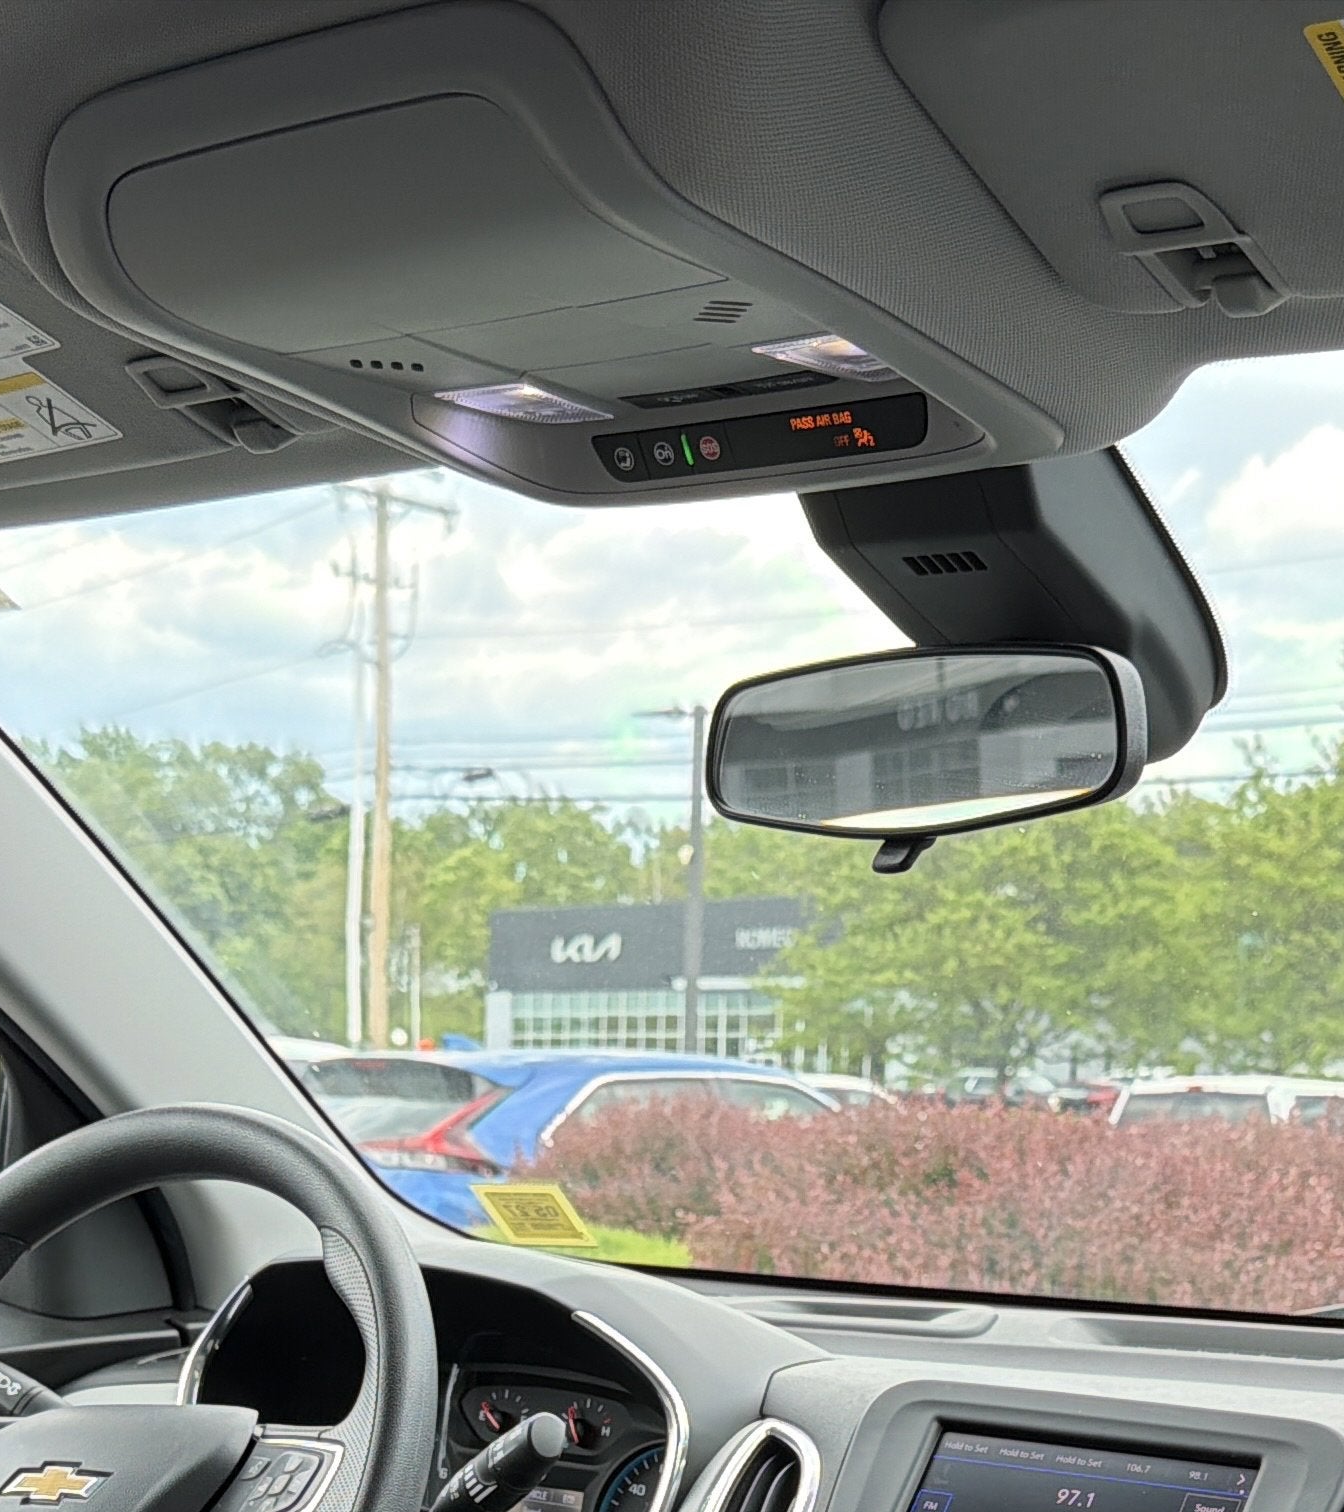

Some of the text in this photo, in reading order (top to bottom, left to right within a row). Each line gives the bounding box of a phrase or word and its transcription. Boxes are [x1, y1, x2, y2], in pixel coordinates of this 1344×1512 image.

[789, 410, 852, 431] PASS AIR BAG
[834, 434, 850, 447] OFF
[944, 1441, 963, 1451] Hold
[973, 1443, 989, 1454] Set
[999, 1448, 1019, 1458] Hold
[1028, 1450, 1045, 1461] Set
[1056, 1454, 1076, 1465] Hold
[1086, 1457, 1103, 1468] Set
[1126, 1462, 1151, 1474] 106.7
[1188, 1469, 1209, 1481] 98.1
[628, 1483, 646, 1496] 40
[1056, 1488, 1095, 1508] 97.1
[923, 1500, 938, 1511] FM
